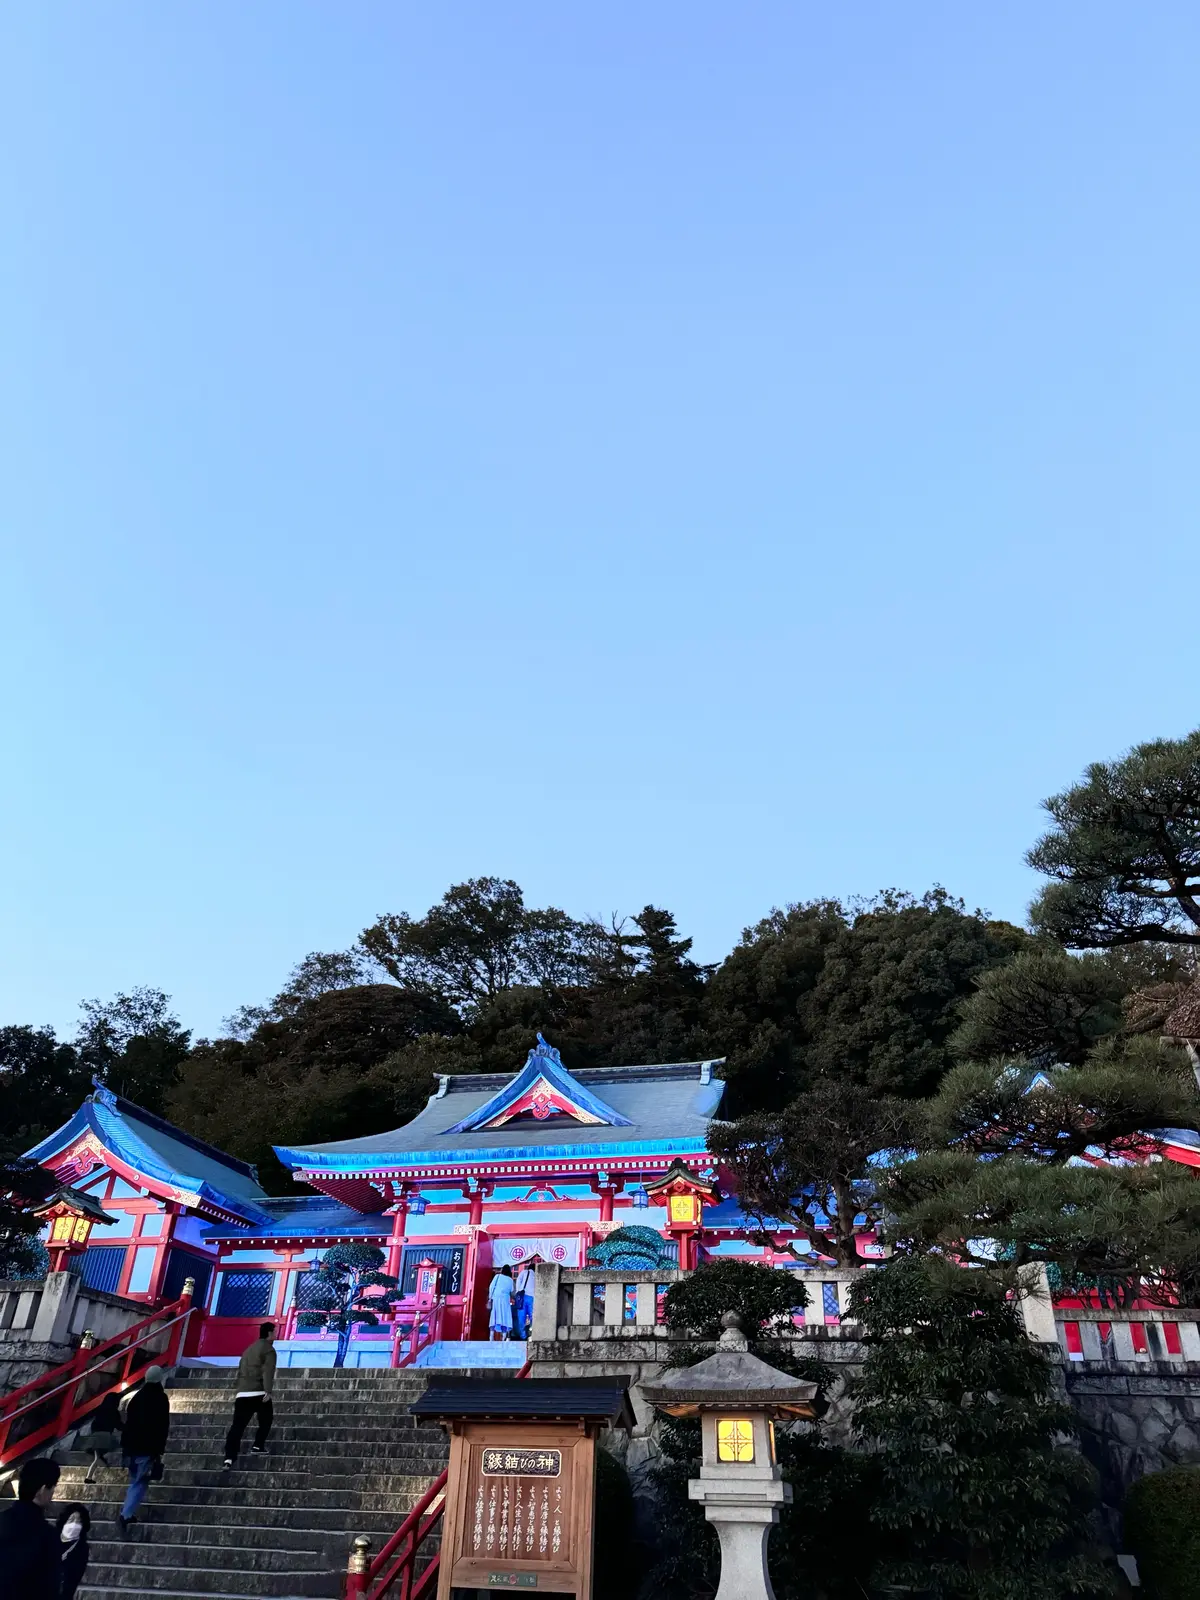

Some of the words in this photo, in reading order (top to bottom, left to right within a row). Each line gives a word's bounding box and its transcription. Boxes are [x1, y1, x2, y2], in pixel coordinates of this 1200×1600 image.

[452, 1251, 461, 1292] おみくじ
[487, 1452, 554, 1471] 縁結びの神
